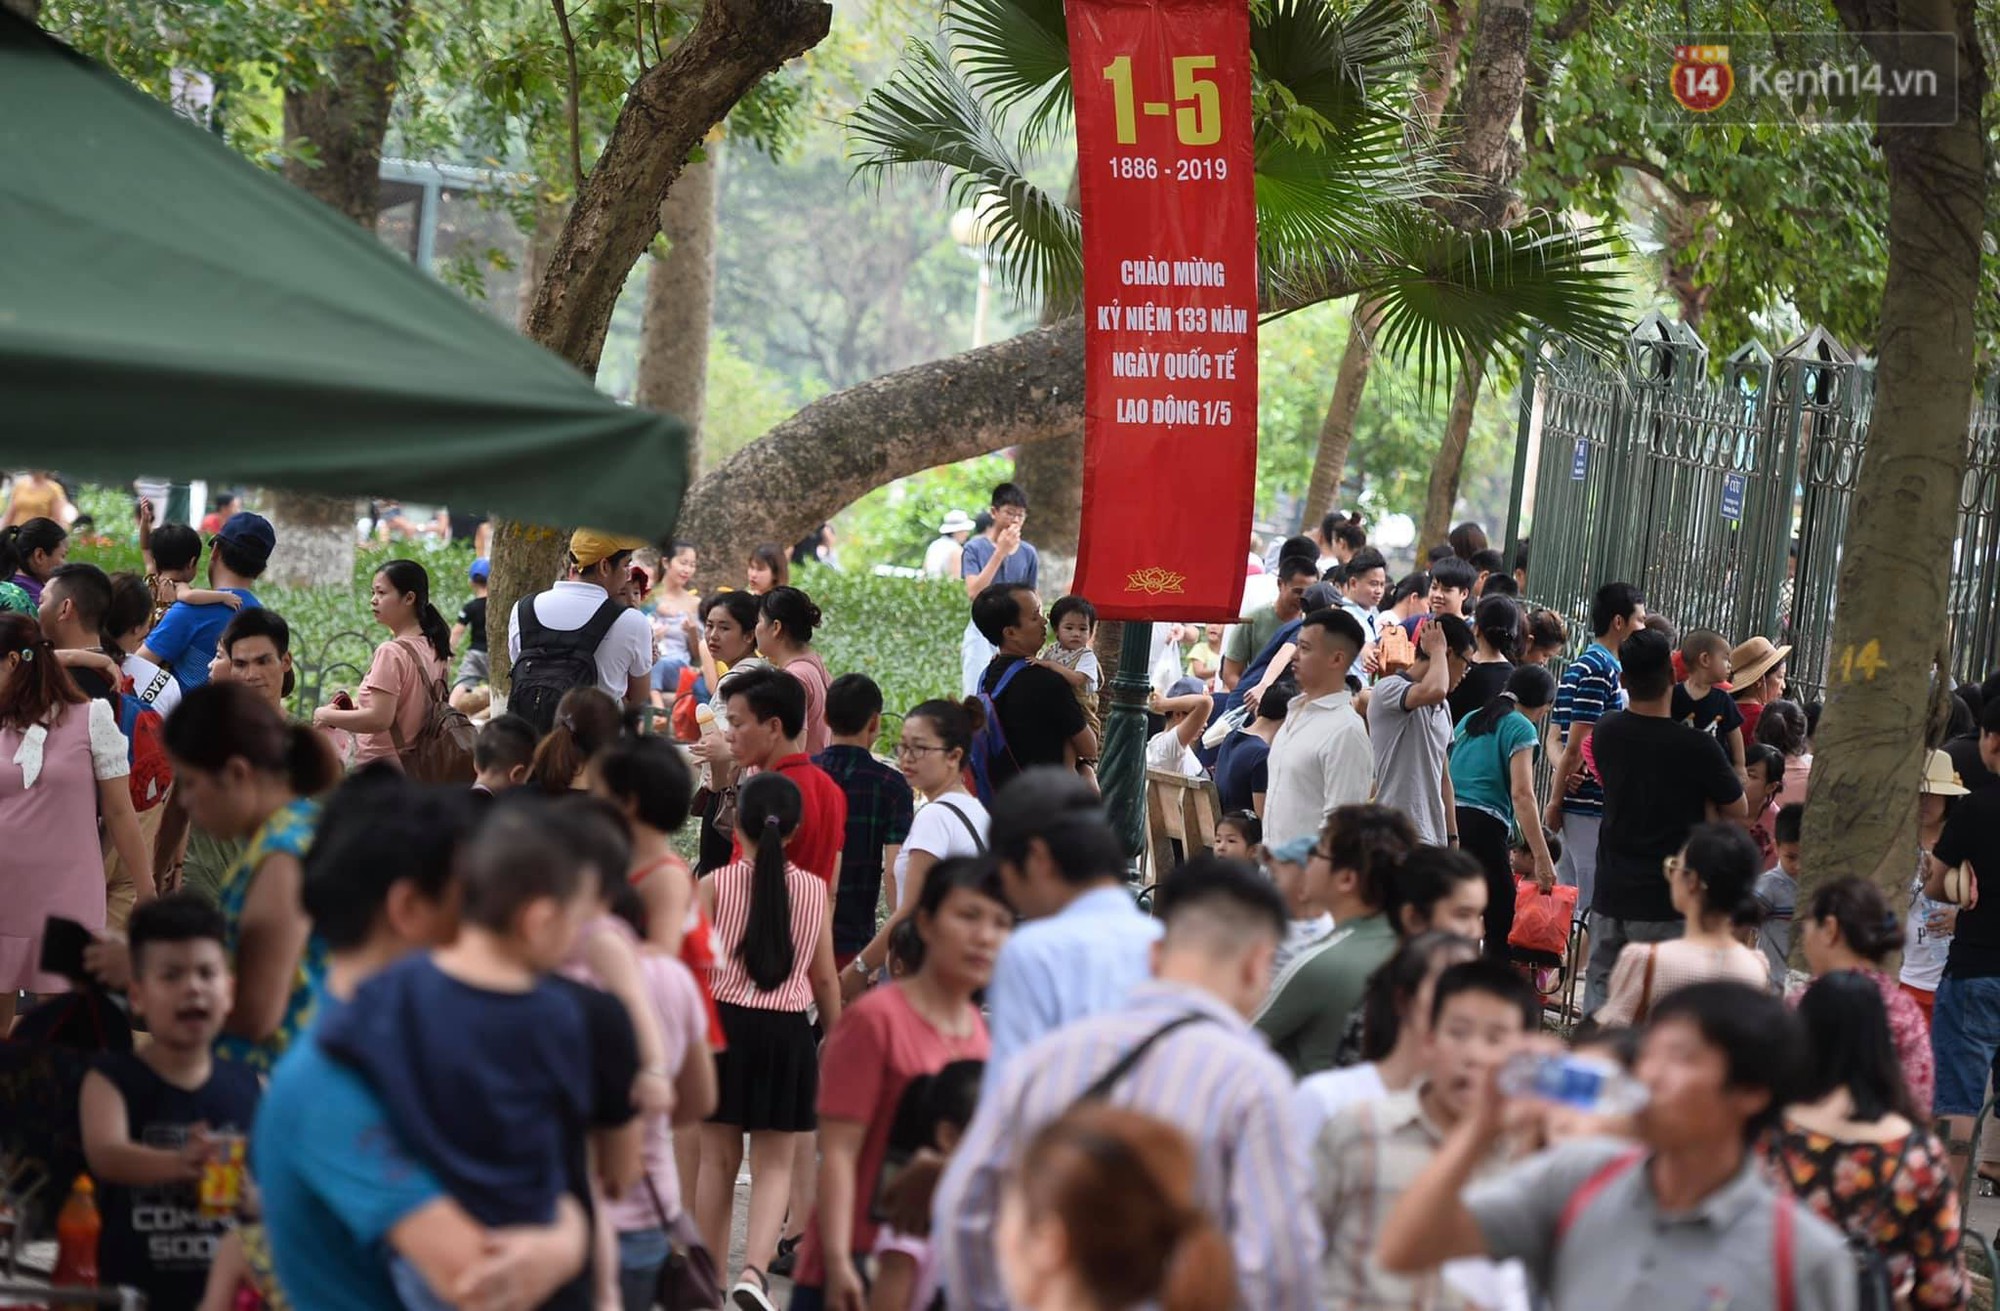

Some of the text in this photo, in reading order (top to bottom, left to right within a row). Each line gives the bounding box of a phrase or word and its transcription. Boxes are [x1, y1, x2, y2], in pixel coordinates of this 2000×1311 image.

[1103, 55, 1221, 145] 1-5
[1109, 157, 1158, 180] 1886
[1177, 158, 1228, 181] 2019
[1121, 255, 1225, 287] CHÀO MỪNG
[1097, 298, 1248, 336] KỶ NIỆM 133 NĂM
[1113, 347, 1238, 381] NGÀY QUỐC TẾ
[1117, 394, 1232, 429] LAO ĐỘNG 1/5
[1840, 638, 1888, 682] 14
